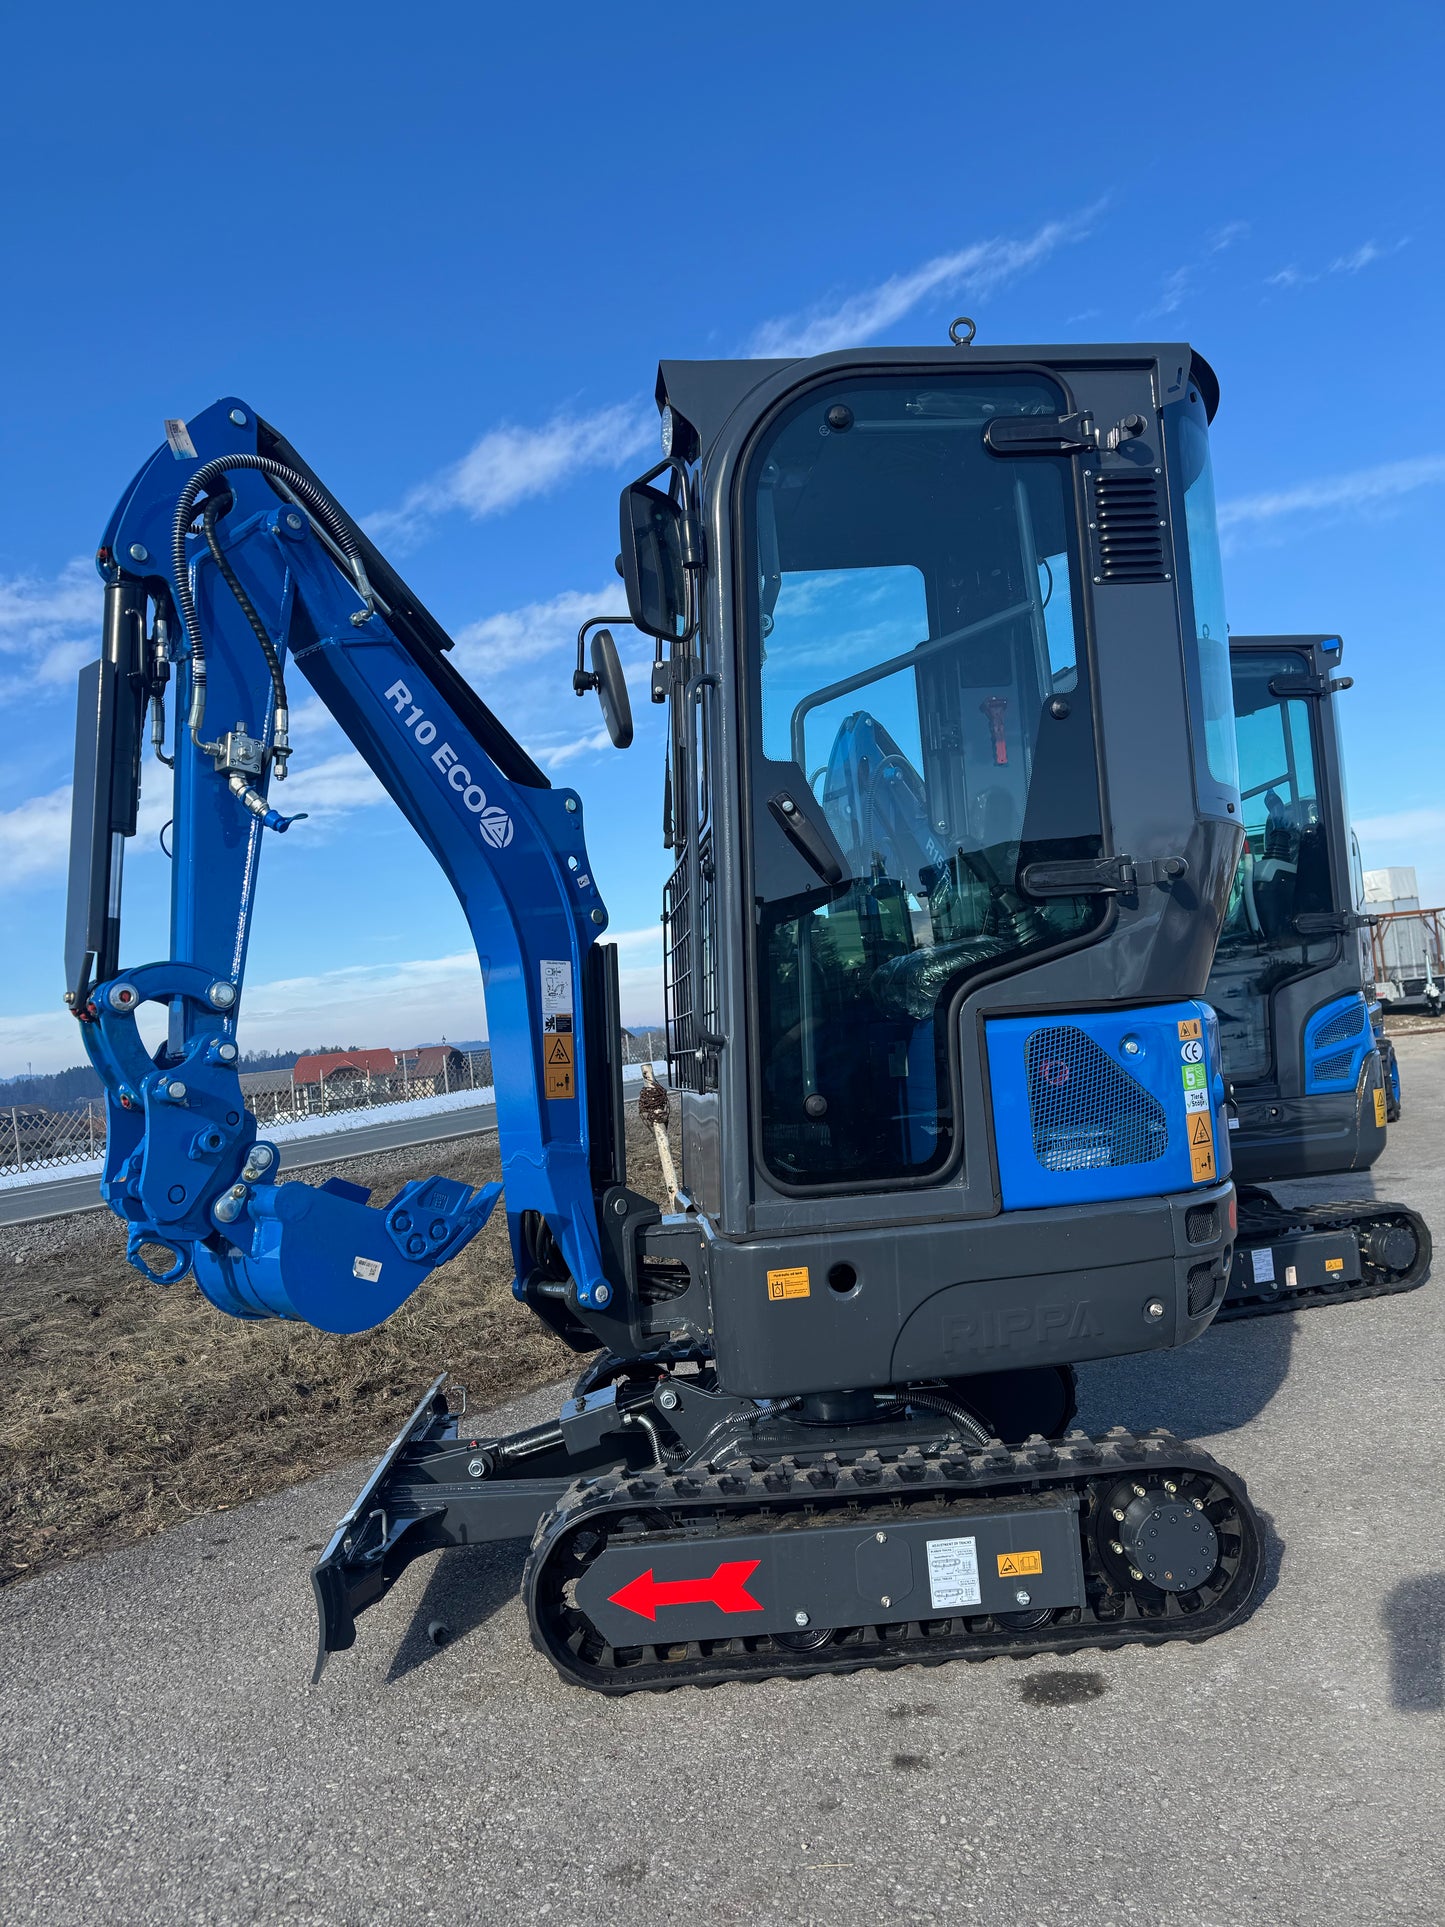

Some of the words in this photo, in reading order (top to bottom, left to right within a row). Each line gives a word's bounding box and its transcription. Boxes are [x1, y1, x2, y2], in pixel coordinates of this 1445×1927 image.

[384, 679, 437, 746] R10
[431, 742, 487, 813] ECO
[941, 1300, 1104, 1354] RIPPA
